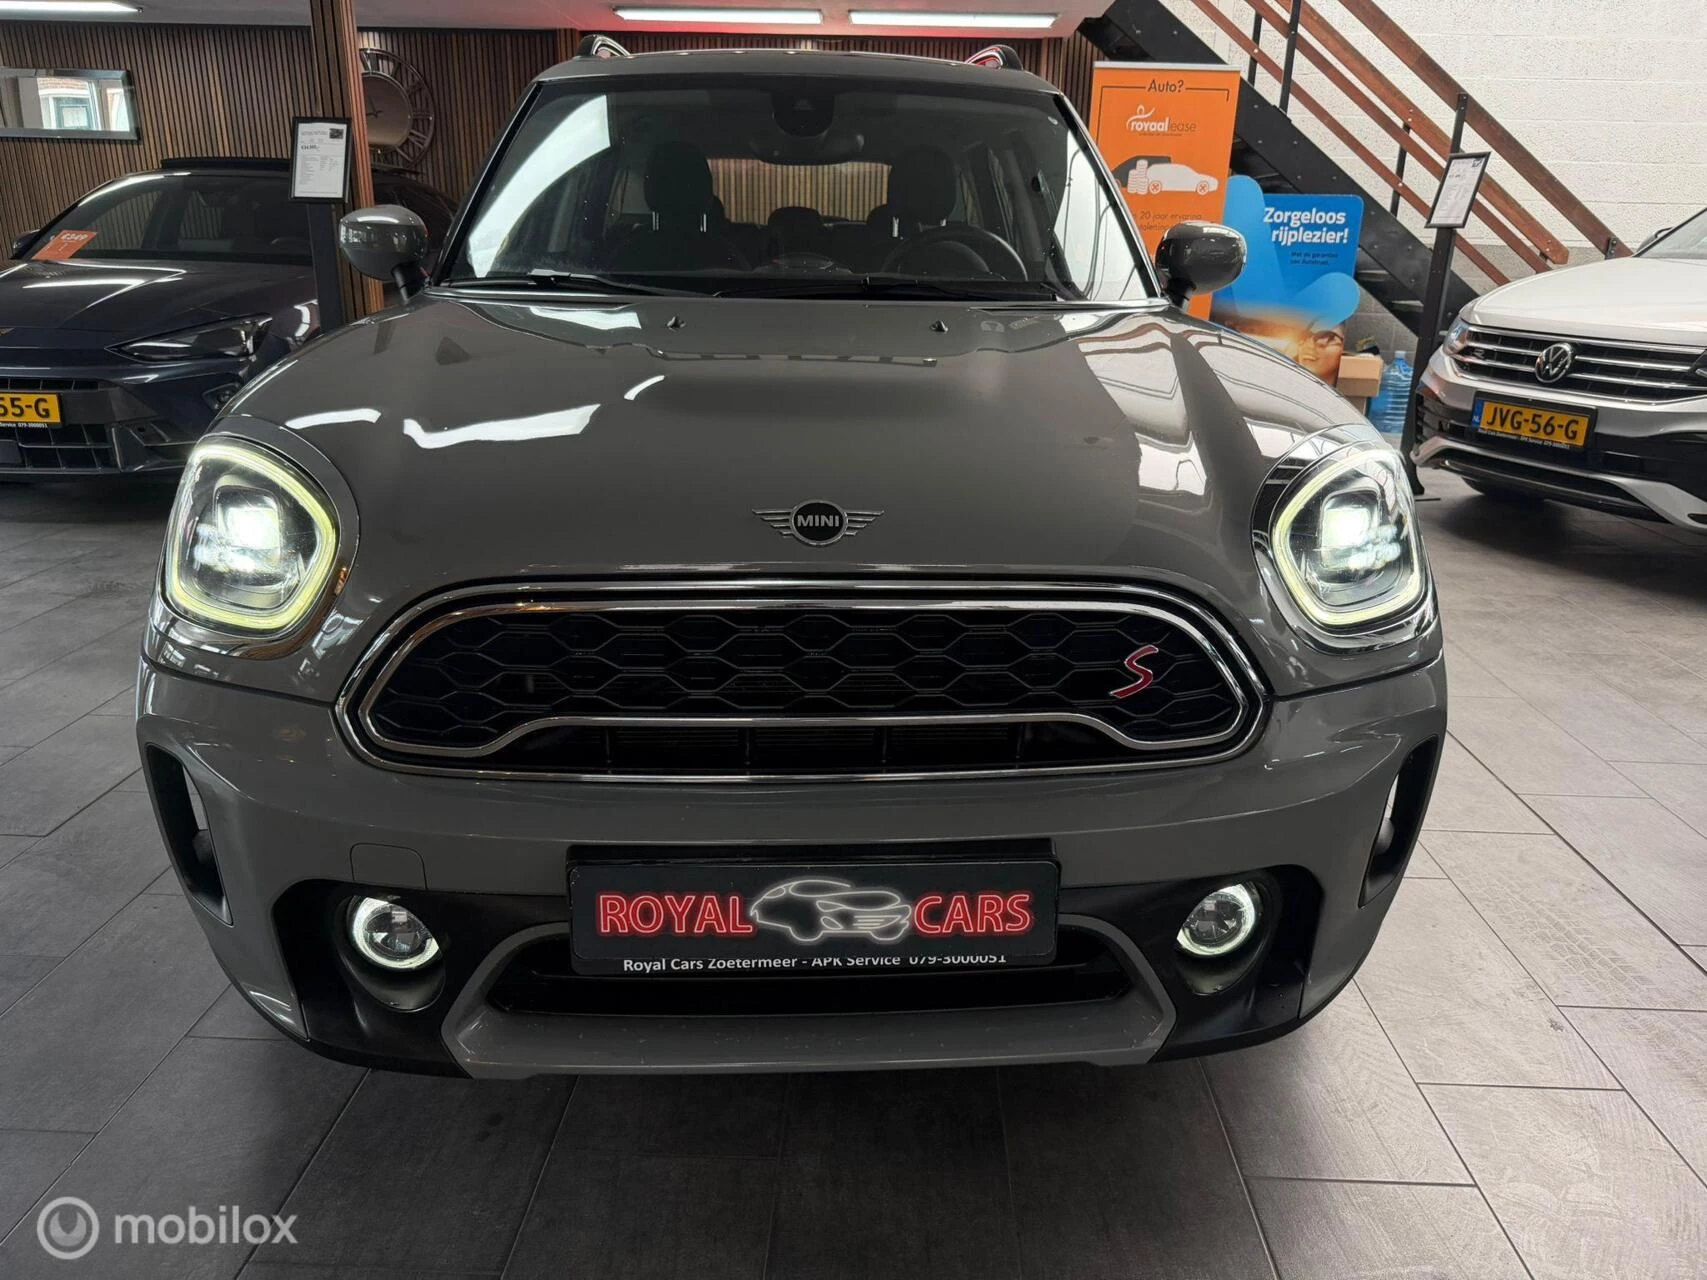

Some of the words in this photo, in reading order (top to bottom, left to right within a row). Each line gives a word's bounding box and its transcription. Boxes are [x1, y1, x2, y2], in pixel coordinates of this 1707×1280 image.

[1147, 79, 1184, 93] Auto?
[1263, 207, 1347, 228] Zorgeloos
[1271, 226, 1349, 246] rijplezier!
[1486, 406, 1580, 441] JVG-56-G
[797, 515, 840, 527] MINI
[1108, 644, 1159, 699] S
[598, 893, 754, 935] ROYAL
[912, 892, 1032, 934] CARS
[623, 958, 666, 973] Royal
[670, 958, 704, 971] Cars
[707, 957, 798, 970] Zoetermeer
[811, 957, 843, 967] APK
[846, 957, 901, 967] Service
